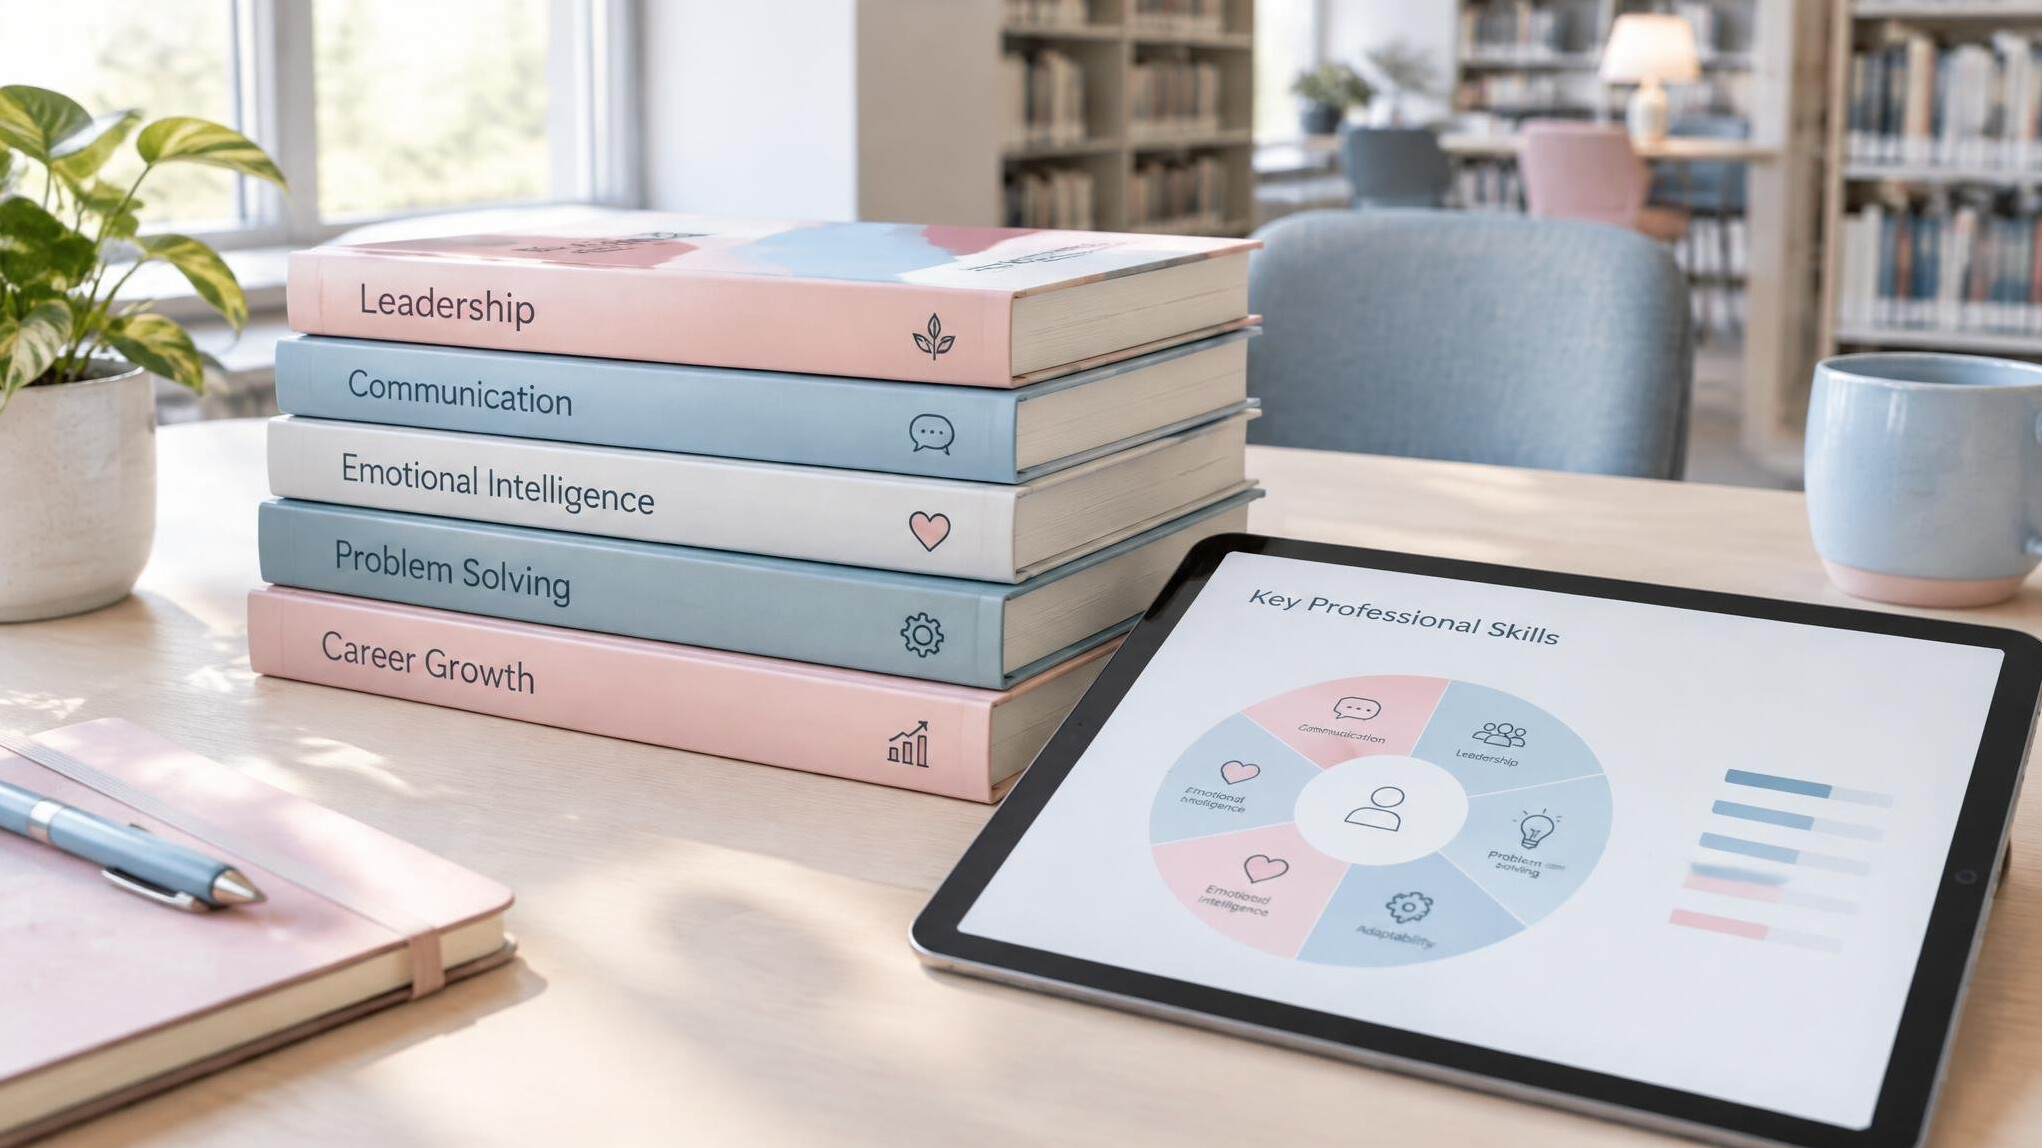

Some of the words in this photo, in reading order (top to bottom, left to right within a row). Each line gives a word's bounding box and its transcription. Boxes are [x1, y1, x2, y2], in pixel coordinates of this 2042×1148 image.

[360, 282, 536, 332] Leadership
[348, 368, 573, 417] Communication
[342, 452, 478, 496] Emotional
[488, 468, 655, 516] Intelligence
[335, 539, 453, 585] Problem
[462, 557, 571, 609] Solving
[1248, 588, 1303, 611] Key
[1306, 596, 1482, 635] Professional
[1486, 621, 1561, 646] Skills
[321, 630, 417, 674] Career
[424, 648, 535, 695] Growth
[1456, 749, 1519, 767] Leadership
